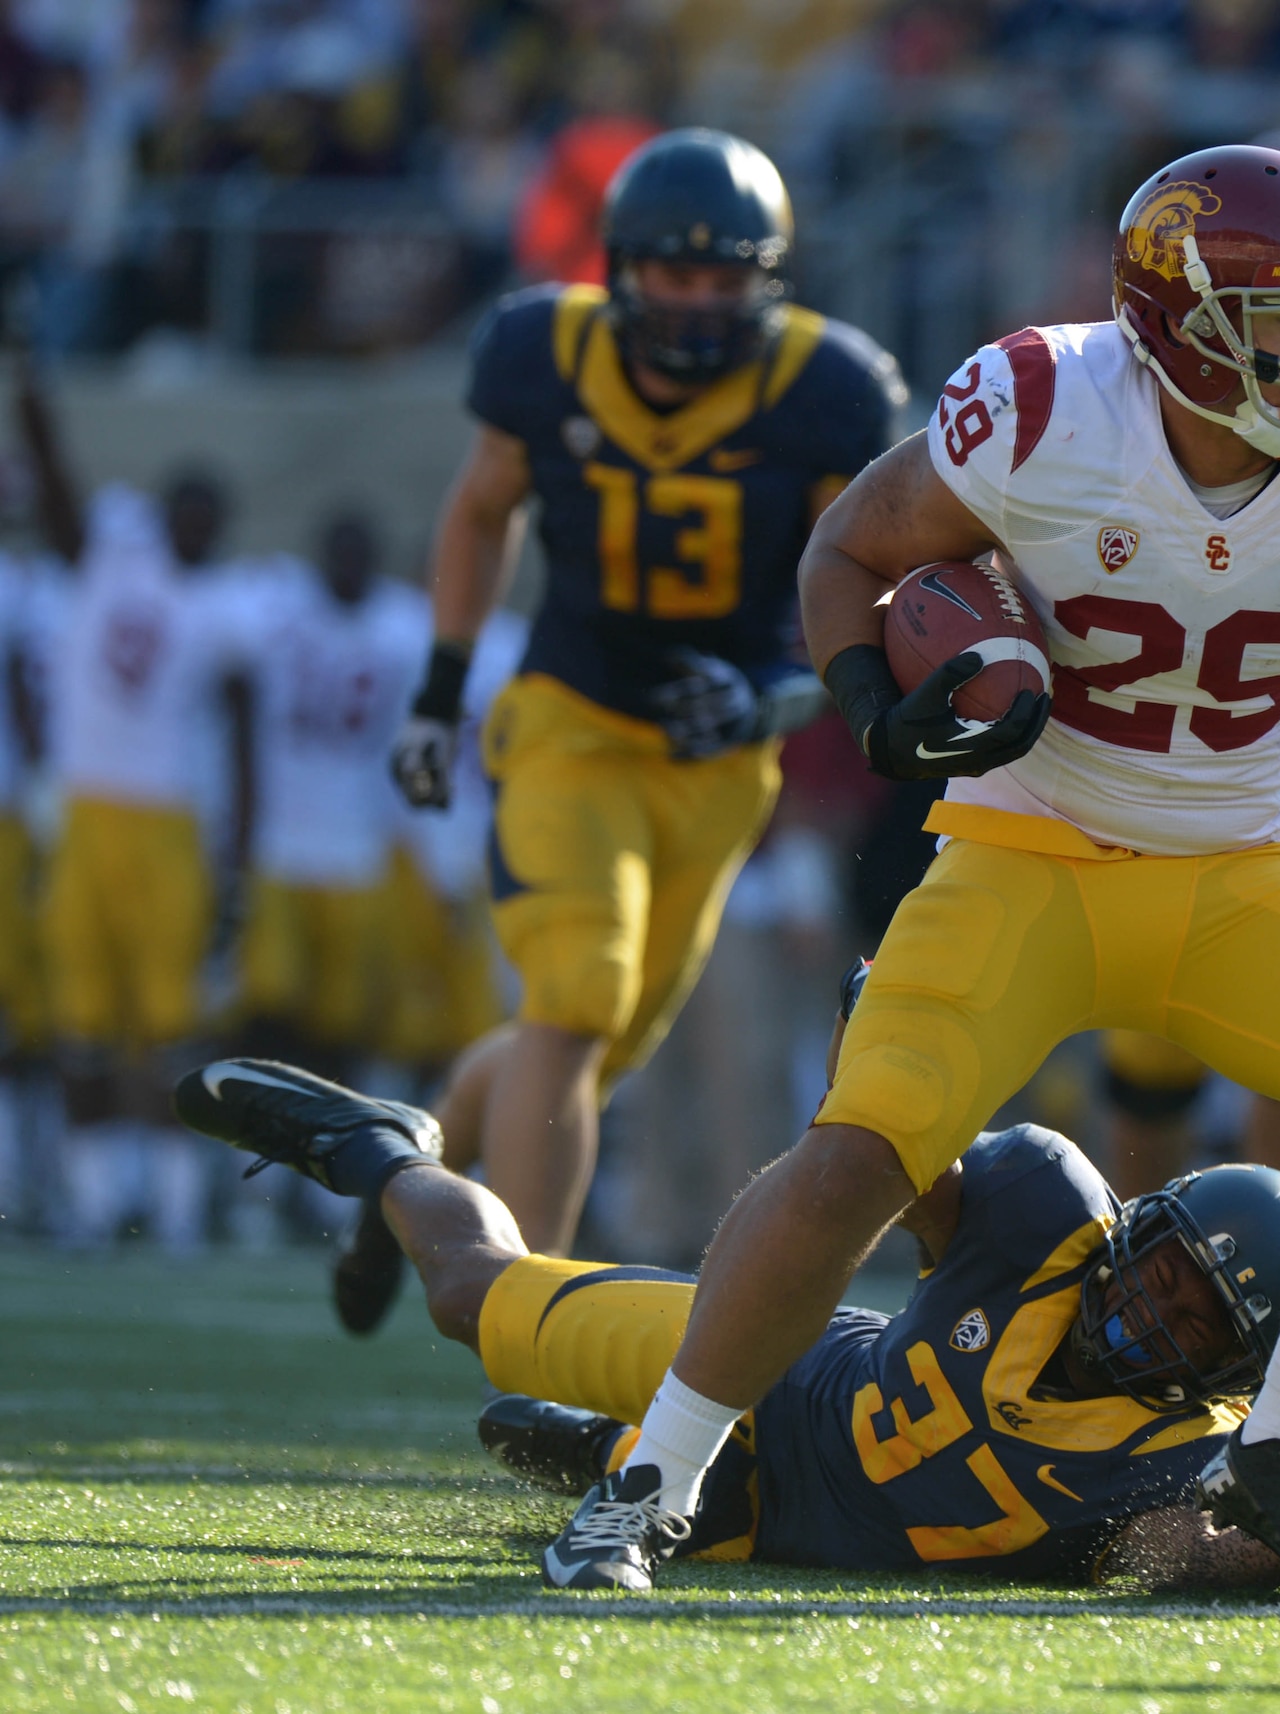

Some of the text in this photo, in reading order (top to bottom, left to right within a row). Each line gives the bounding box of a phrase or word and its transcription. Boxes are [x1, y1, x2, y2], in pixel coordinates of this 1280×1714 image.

[940, 362, 994, 467] 29
[583, 460, 743, 620] 13
[1101, 528, 1136, 558] PAC
[1104, 547, 1124, 566] 12
[1205, 535, 1231, 571] SC
[991, 1401, 1033, 1431] Cal
[851, 1340, 1050, 1562] 37
